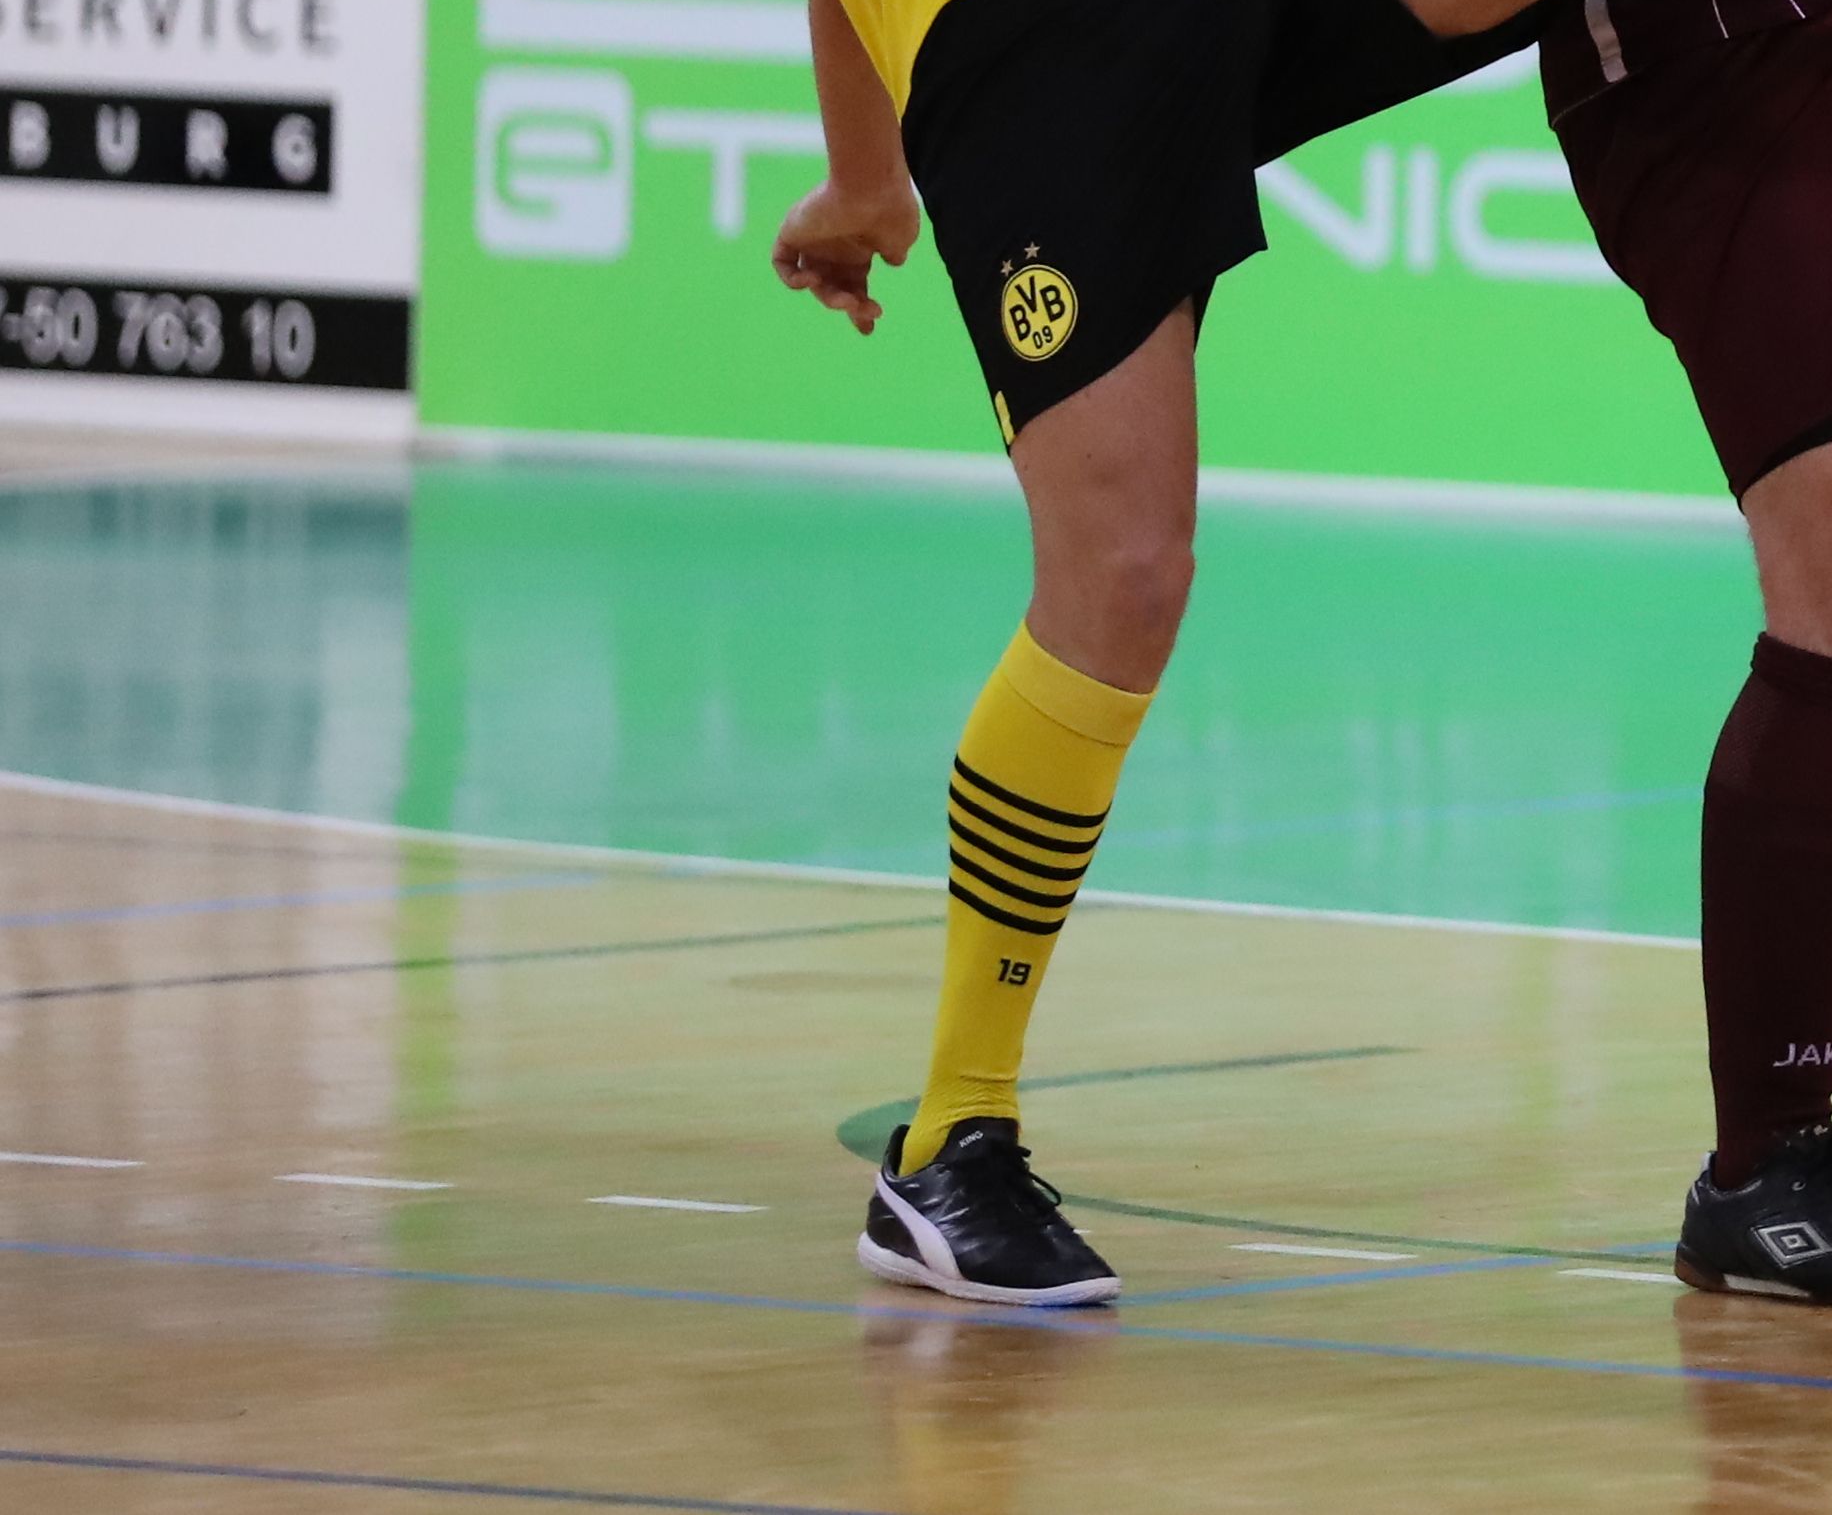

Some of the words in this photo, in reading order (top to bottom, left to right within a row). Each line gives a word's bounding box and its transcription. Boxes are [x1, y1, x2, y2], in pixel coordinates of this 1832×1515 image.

[7, 98, 319, 184] BURG
[1009, 275, 1066, 342] BVB
[112, 290, 224, 374] 763
[241, 297, 316, 378] 10
[1032, 325, 1054, 350] 09
[997, 958, 1032, 986] 19
[959, 1130, 984, 1148] KING
